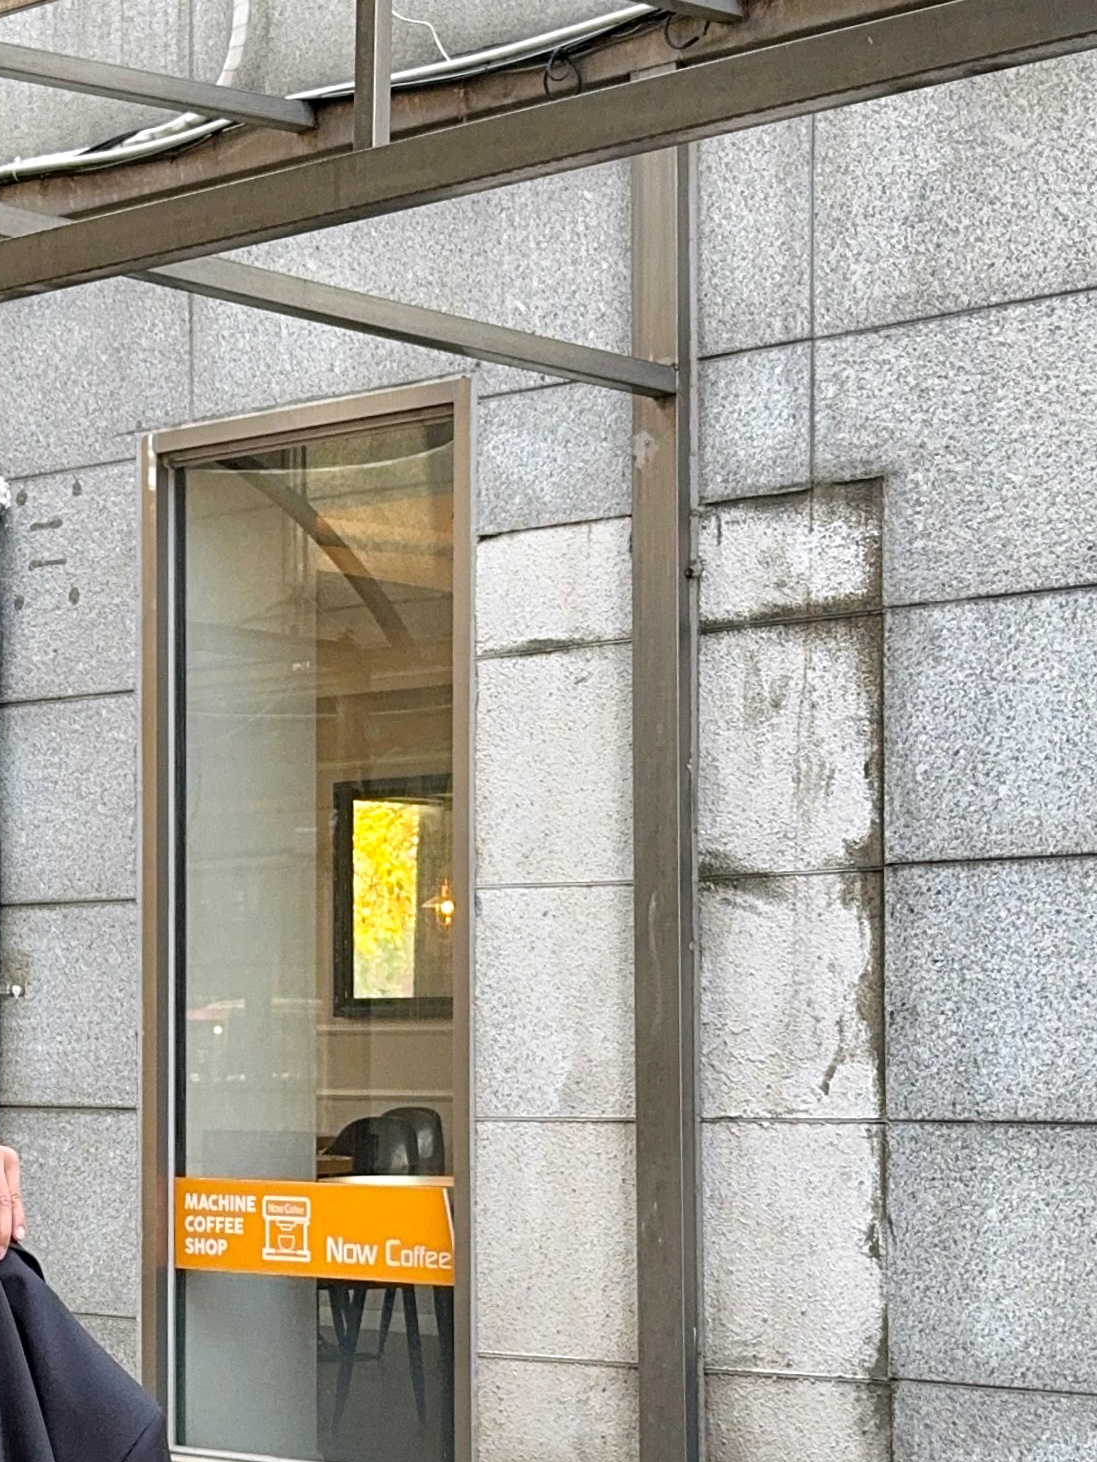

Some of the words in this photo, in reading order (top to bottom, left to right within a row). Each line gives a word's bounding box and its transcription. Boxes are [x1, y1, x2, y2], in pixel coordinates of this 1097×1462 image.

[184, 1193, 257, 1213] MACHINE
[184, 1215, 245, 1235] COFFEE
[184, 1237, 228, 1256] SHOP
[325, 1235, 377, 1265] Now
[385, 1238, 452, 1269] Coffee
